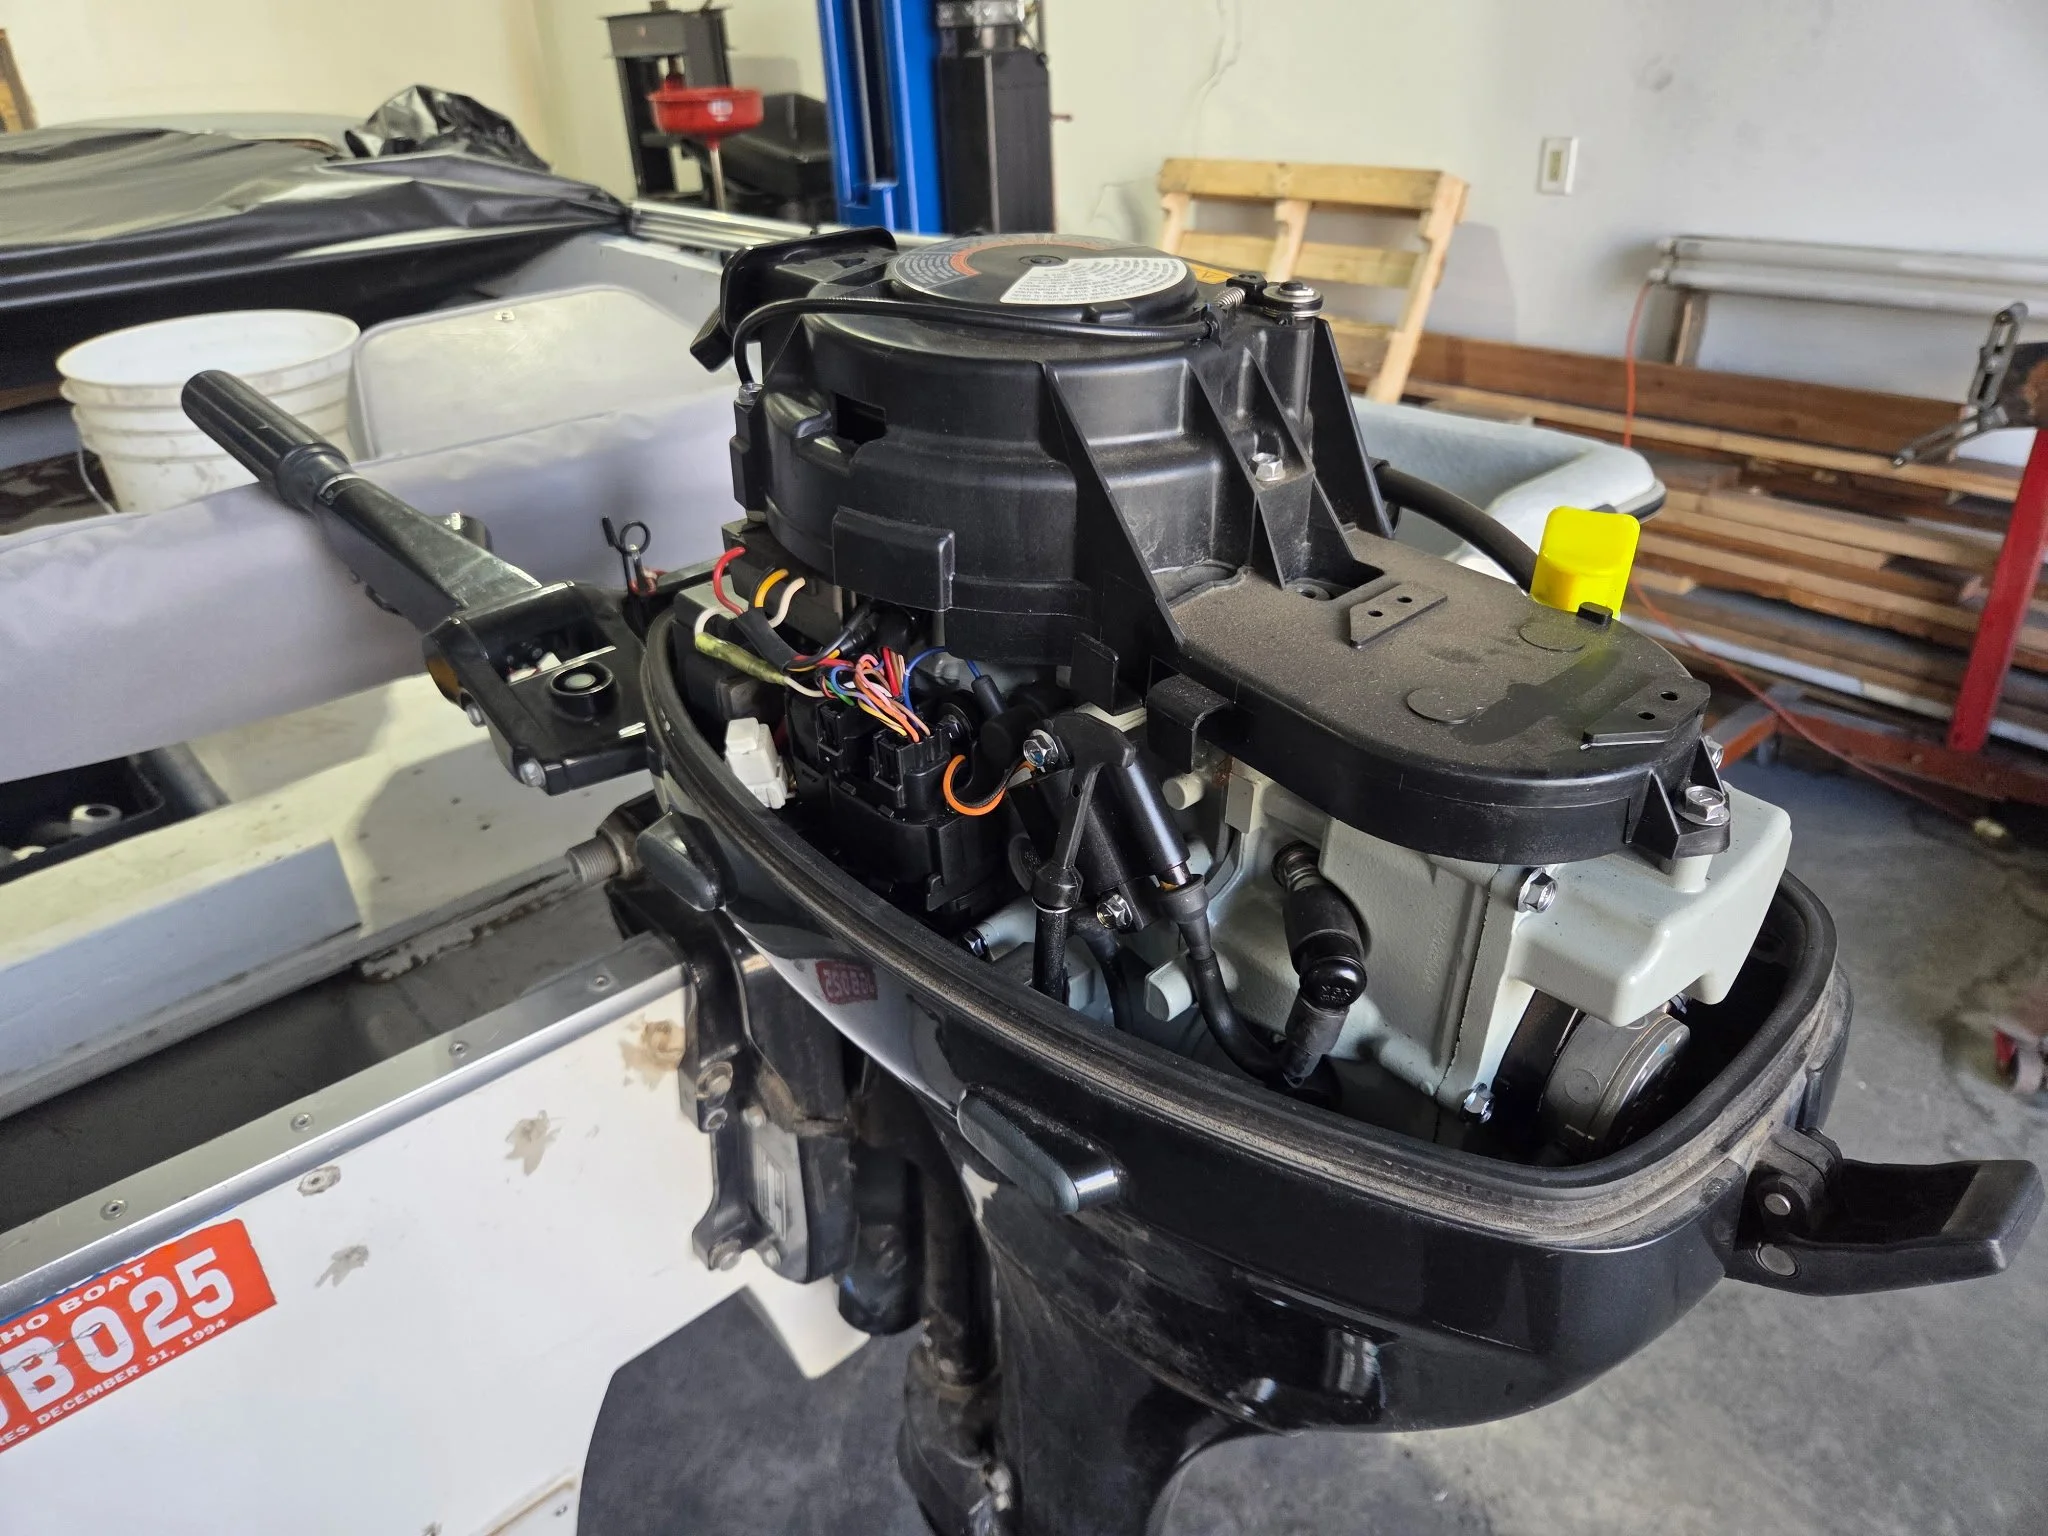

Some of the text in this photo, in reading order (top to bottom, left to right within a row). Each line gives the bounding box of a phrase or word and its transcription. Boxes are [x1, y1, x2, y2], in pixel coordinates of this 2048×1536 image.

[0, 1262, 146, 1346] HO BOAT
[37, 1365, 140, 1425] DECEMBER
[146, 1349, 176, 1367] 31,
[182, 1318, 227, 1348] 1994
